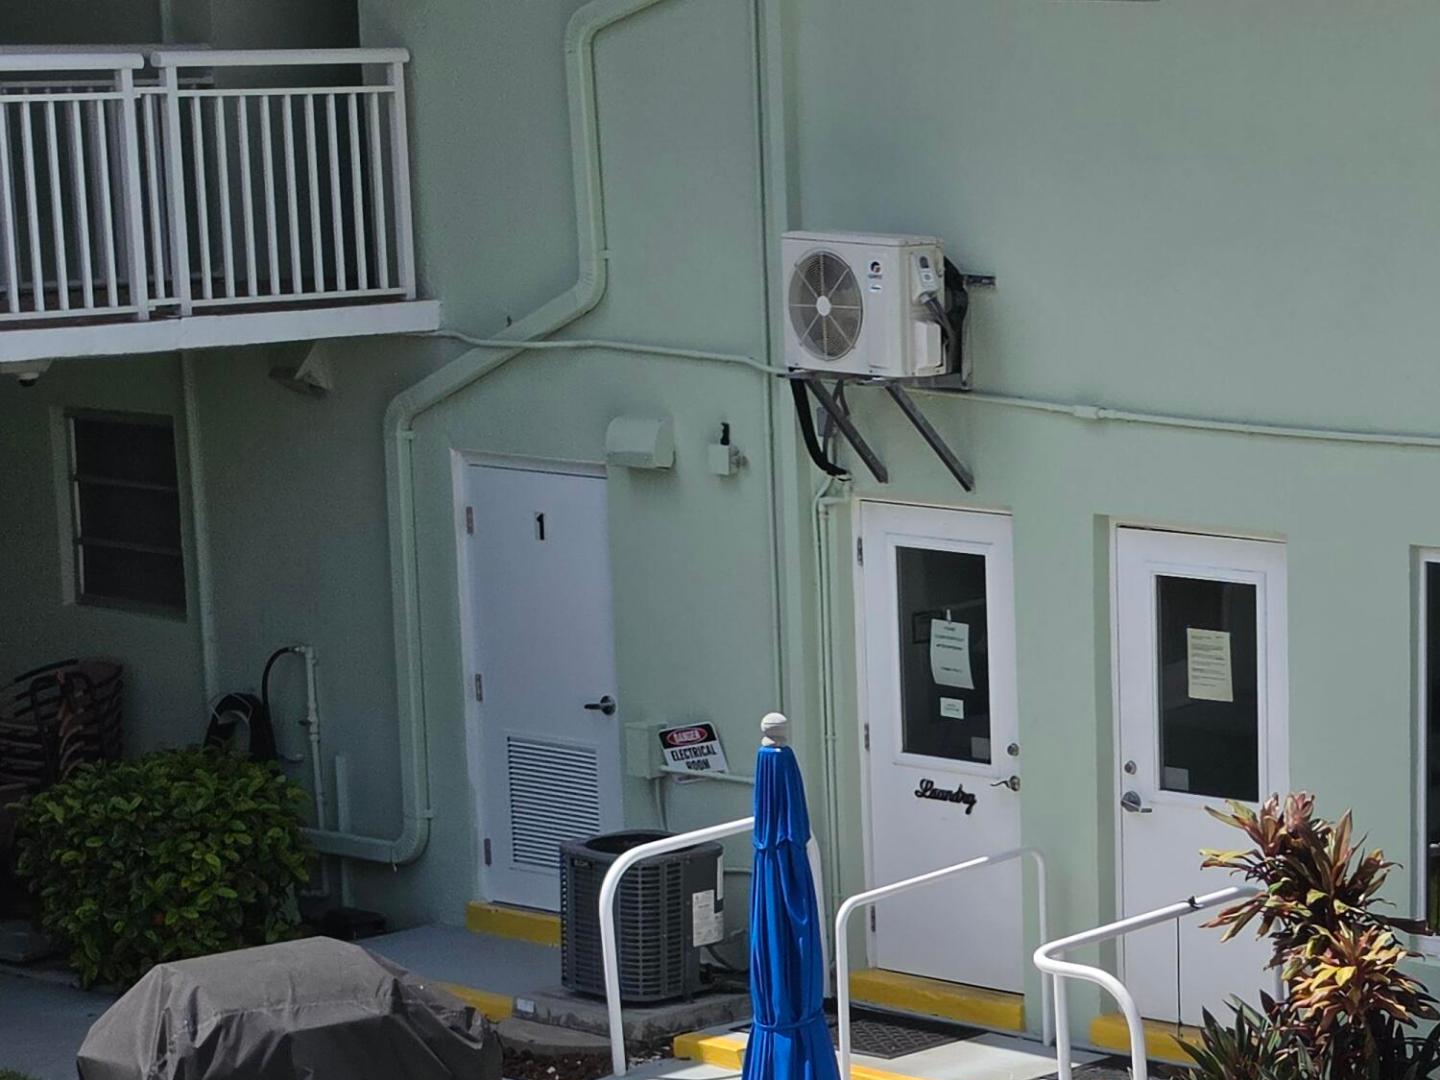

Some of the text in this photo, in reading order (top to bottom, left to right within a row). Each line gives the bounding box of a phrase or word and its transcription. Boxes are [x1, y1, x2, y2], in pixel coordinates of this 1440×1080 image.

[536, 512, 545, 541] 1
[670, 744, 717, 761] ELECTRICAL
[915, 778, 977, 815] Laundry
